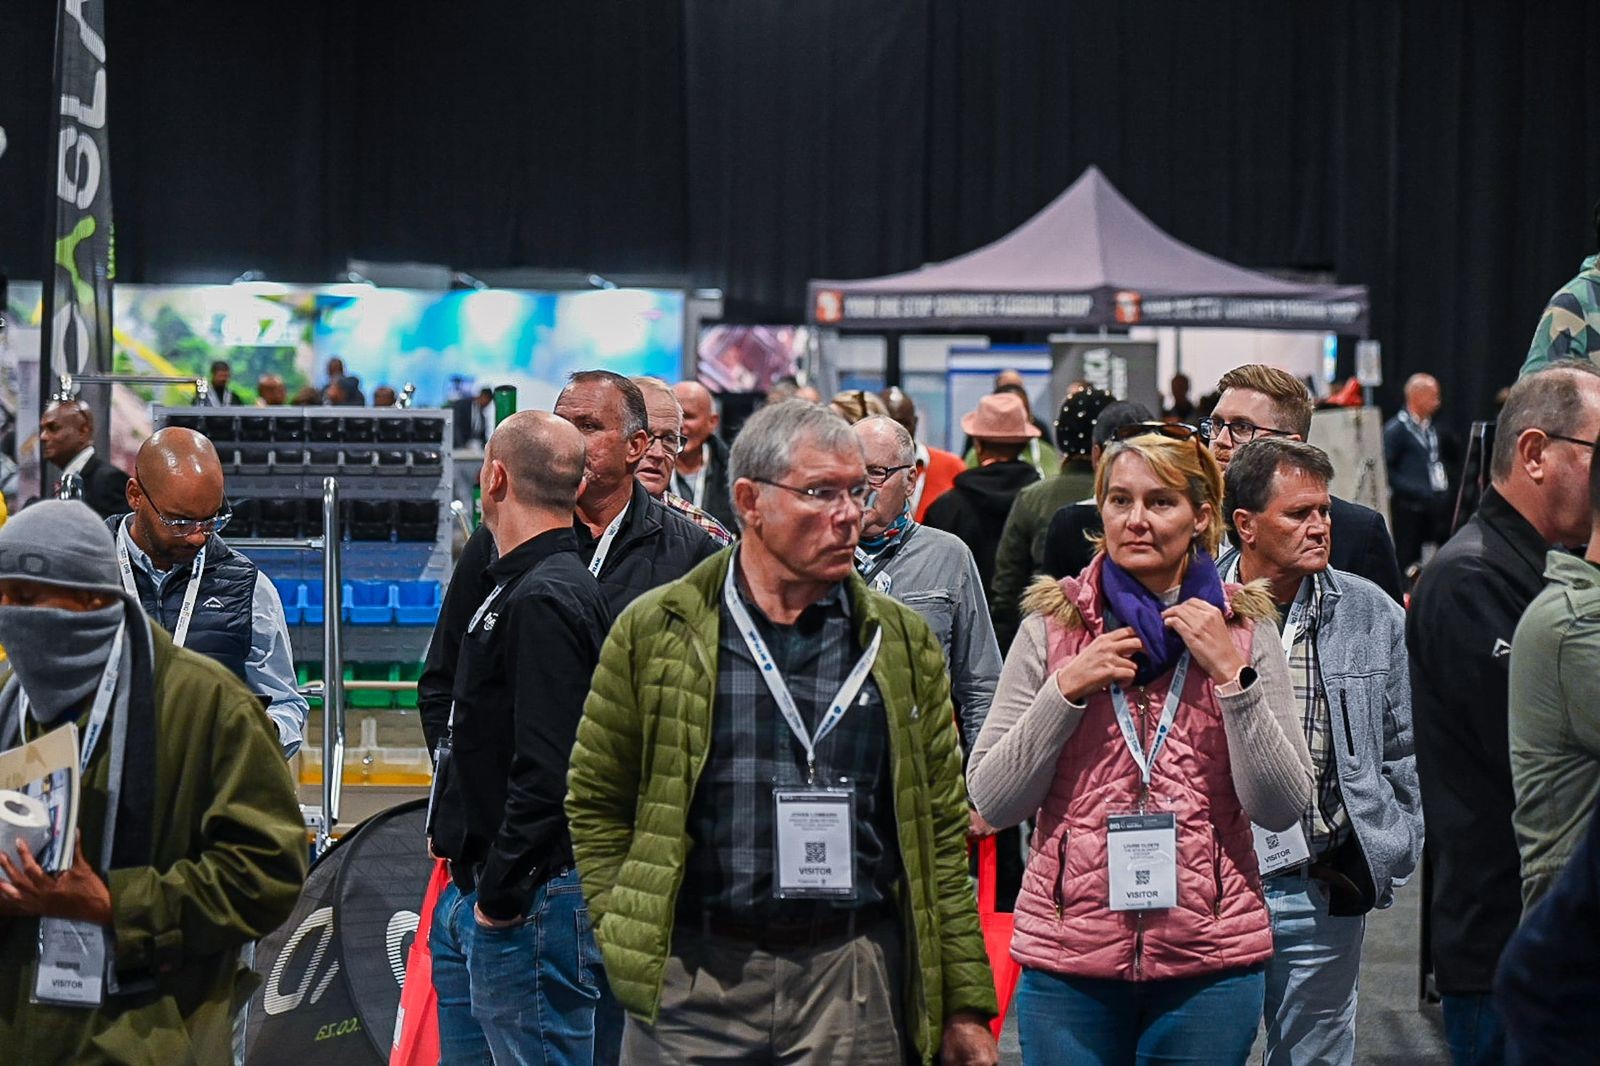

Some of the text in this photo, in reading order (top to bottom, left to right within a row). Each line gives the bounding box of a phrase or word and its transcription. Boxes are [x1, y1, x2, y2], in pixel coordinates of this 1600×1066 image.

[1264, 848, 1292, 863] VISITOR
[798, 867, 832, 876] VISITOR
[1126, 890, 1159, 899] VISITOR
[51, 979, 84, 989] VISITOR
